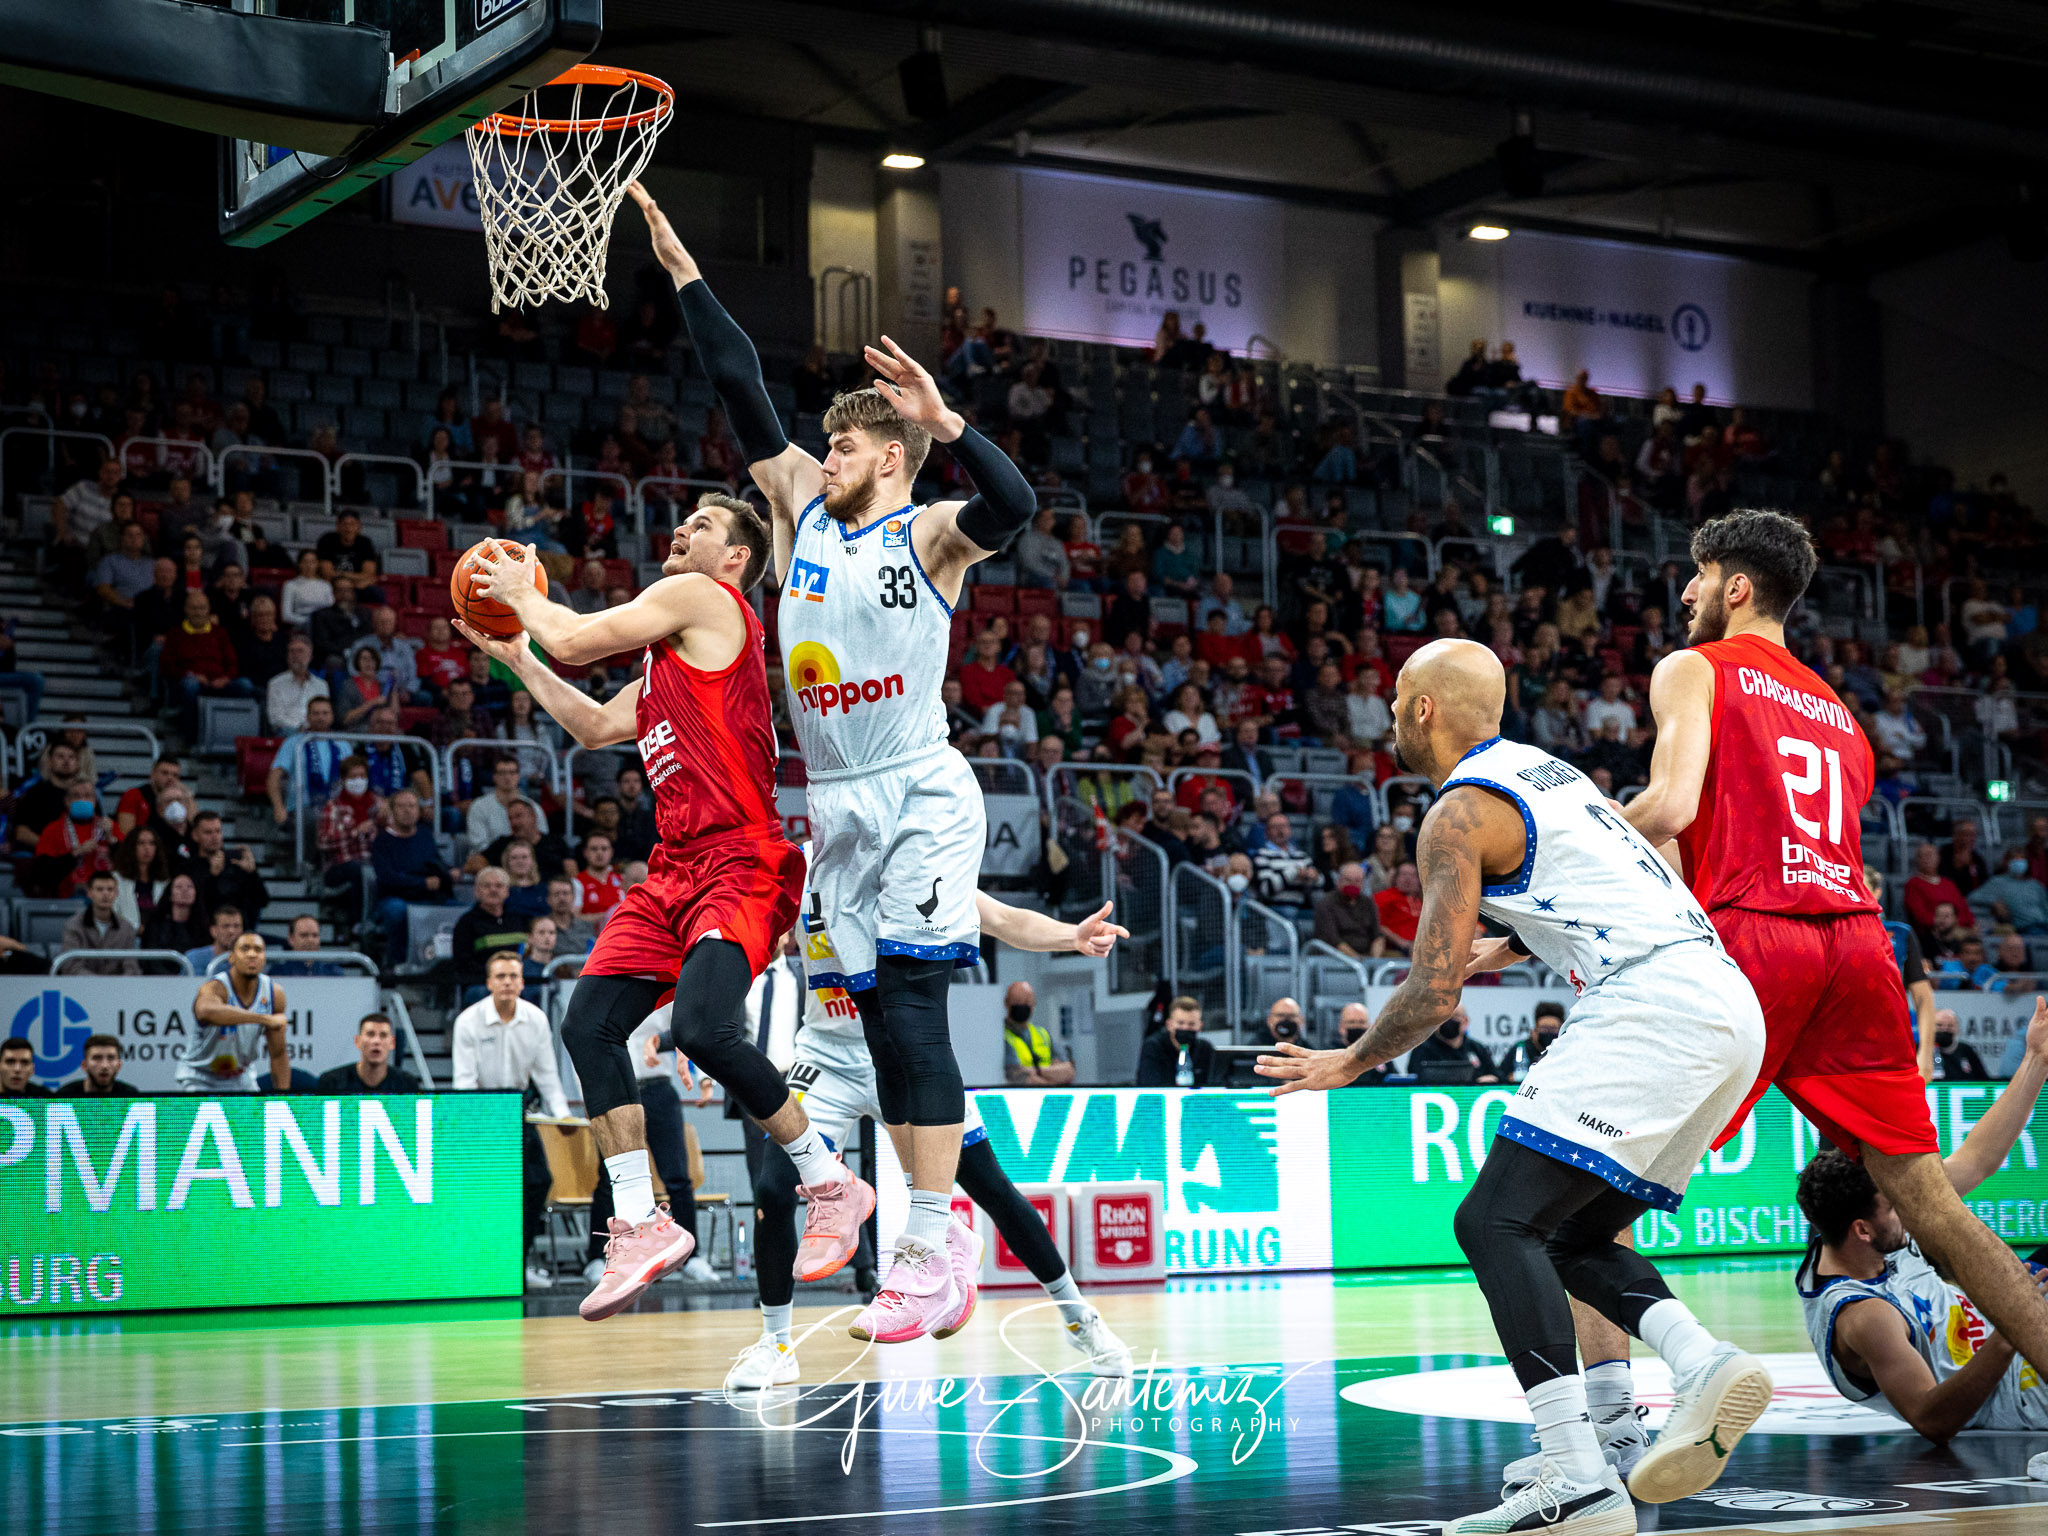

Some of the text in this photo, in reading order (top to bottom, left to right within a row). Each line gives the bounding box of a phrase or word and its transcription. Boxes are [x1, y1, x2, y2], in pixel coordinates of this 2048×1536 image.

[1069, 255, 1242, 308] PEGASUS
[878, 565, 917, 609] 33
[797, 674, 904, 717] nippon
[639, 720, 676, 762] ose
[1777, 735, 1842, 845] 21
[1781, 836, 1850, 885] brose
[117, 1008, 313, 1036] IGAHI
[824, 998, 859, 1020] nip
[1485, 1014, 1531, 1036] IGA
[121, 1043, 188, 1061] MOTO
[0, 1099, 433, 1213] PMANN
[1166, 1227, 1280, 1269] RUNG
[1635, 1208, 1682, 1248] US
[0, 1253, 124, 1305] URG
